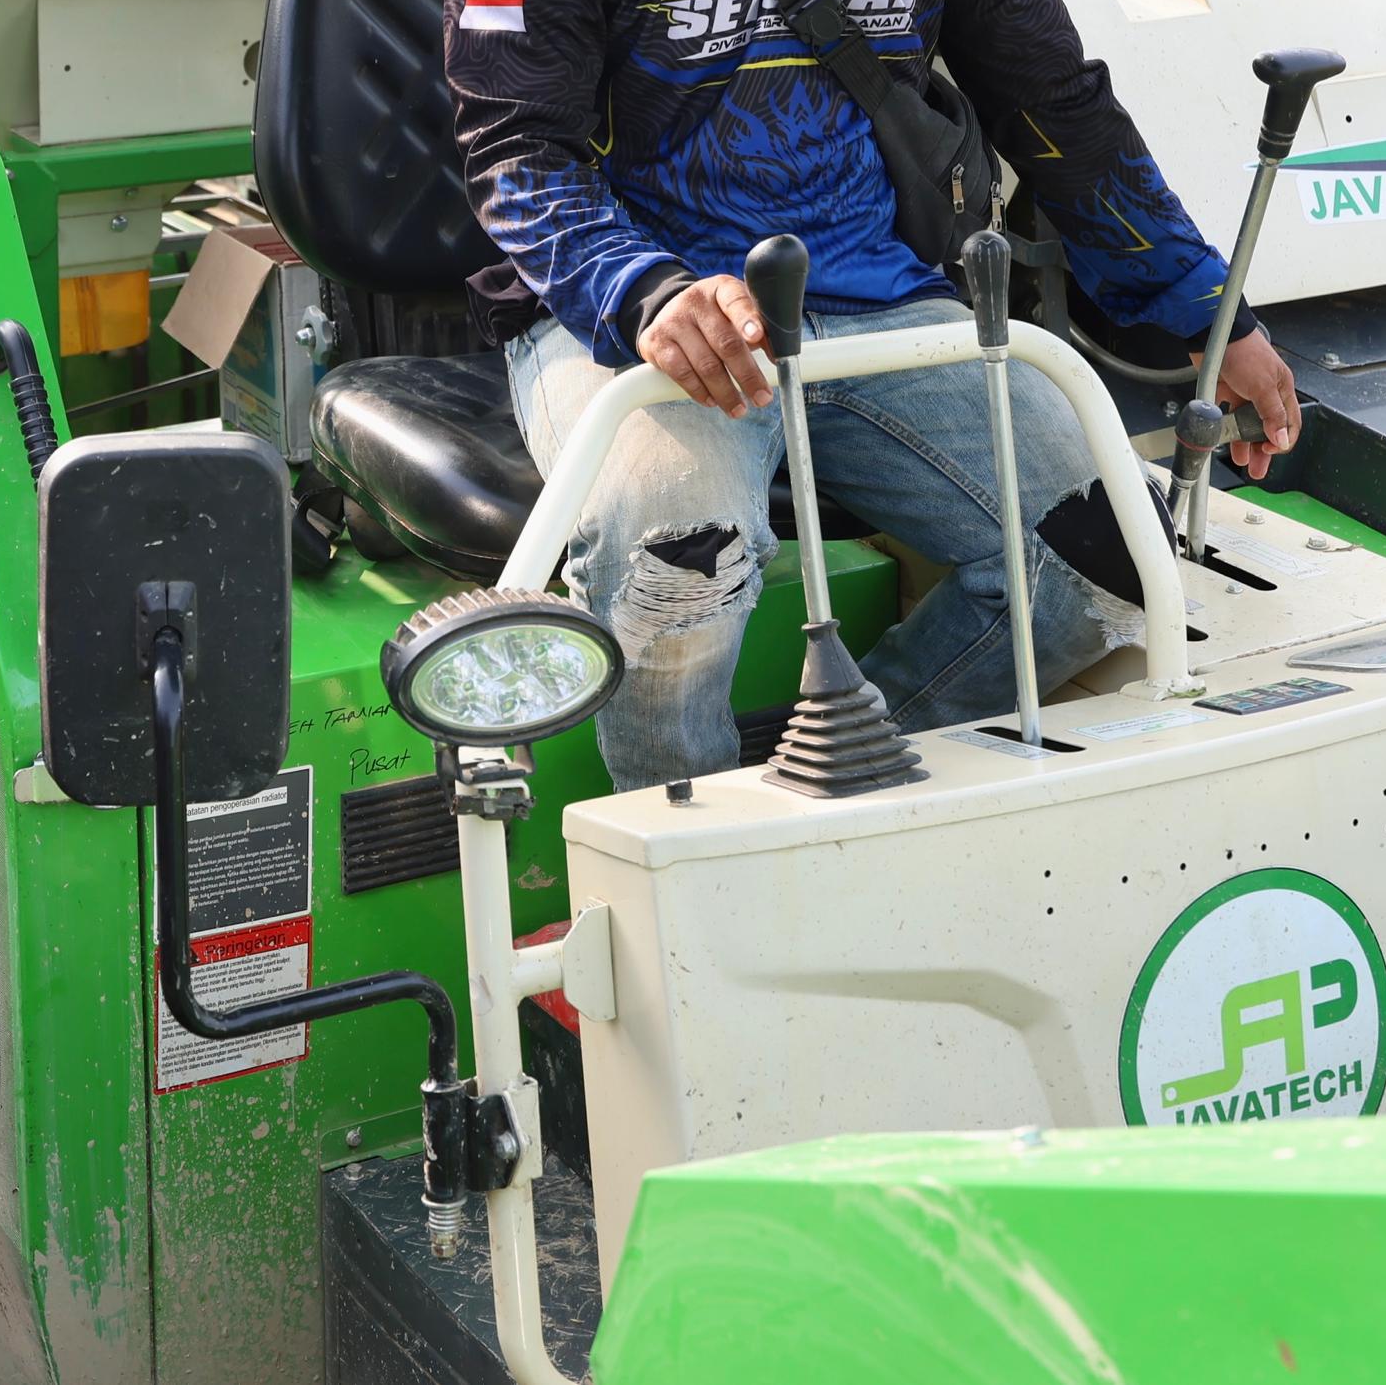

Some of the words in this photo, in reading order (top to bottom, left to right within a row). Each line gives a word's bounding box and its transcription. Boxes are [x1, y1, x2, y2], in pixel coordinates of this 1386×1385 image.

[349, 748, 411, 785] Pusat
[187, 805, 209, 817] atatan
[205, 933, 285, 955] Peringatan
